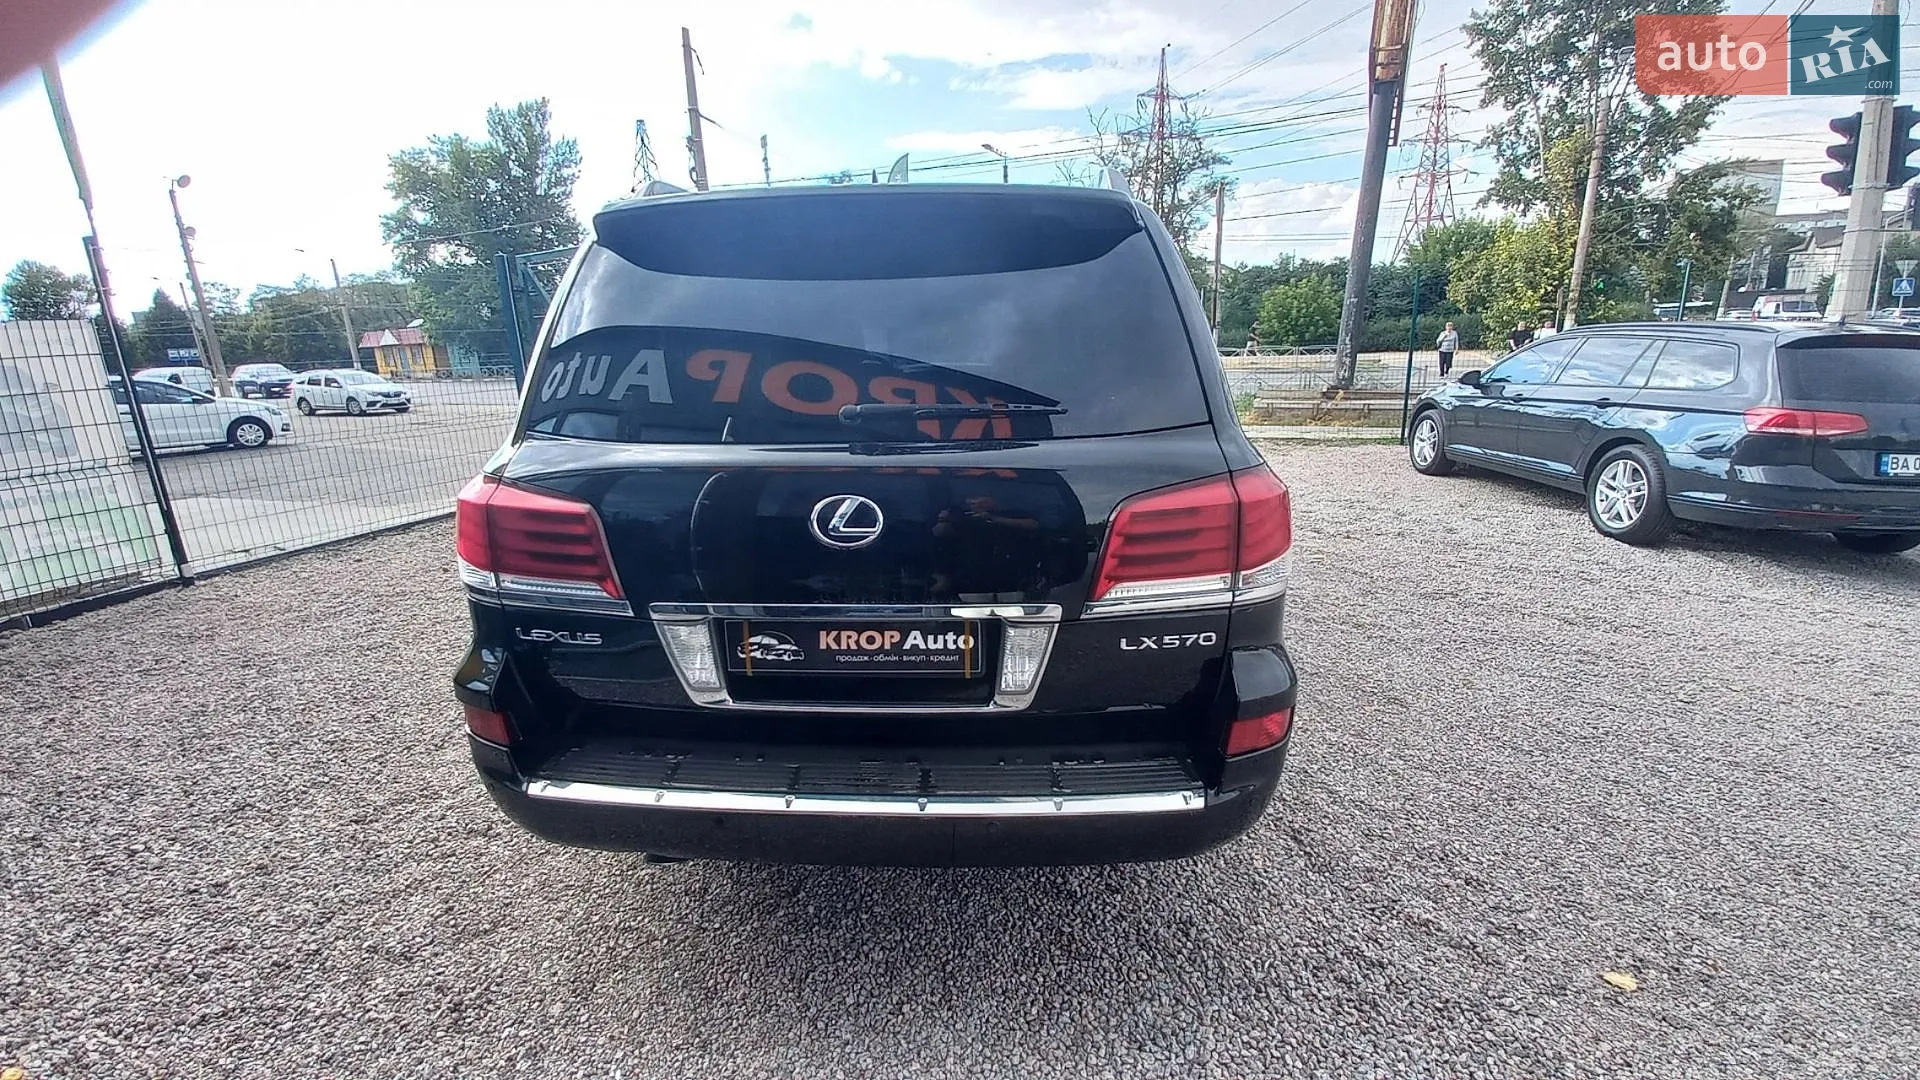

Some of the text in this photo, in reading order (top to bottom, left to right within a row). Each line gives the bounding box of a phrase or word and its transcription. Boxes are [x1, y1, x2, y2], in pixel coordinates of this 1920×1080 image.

[515, 627, 603, 645] LEXUS
[819, 630, 975, 650] KROP Auto
